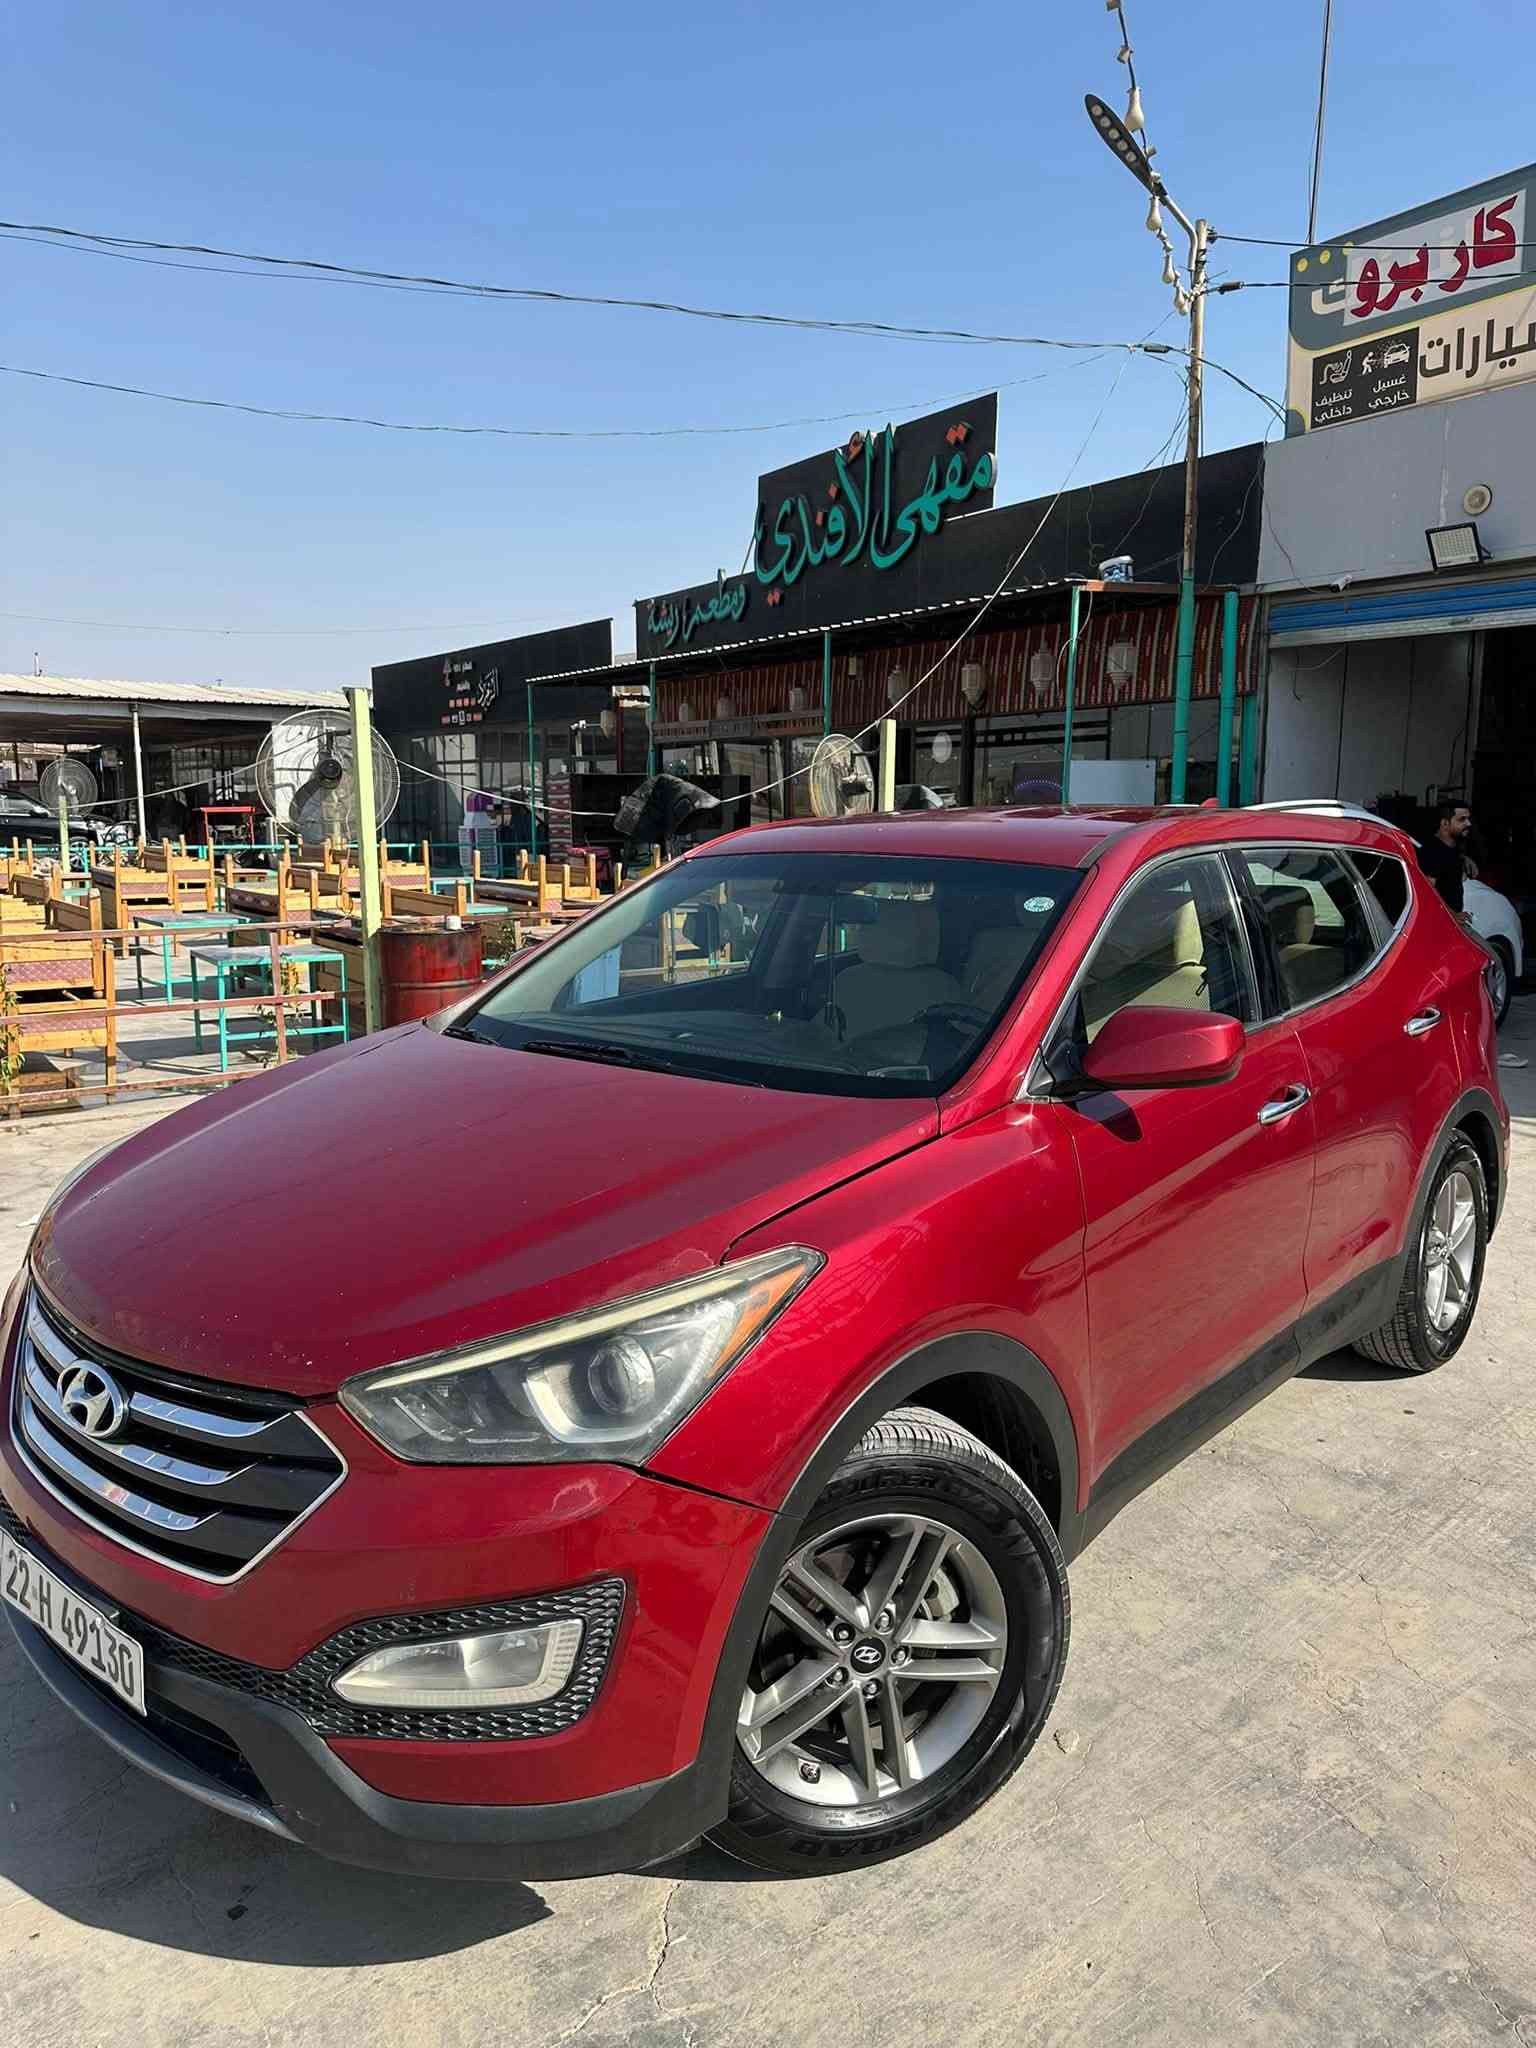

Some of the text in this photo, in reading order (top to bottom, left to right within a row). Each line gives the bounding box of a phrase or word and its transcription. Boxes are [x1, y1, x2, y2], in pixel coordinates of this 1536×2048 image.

[1438, 194, 1518, 293] كار
[1350, 242, 1430, 318] برو
[1372, 373, 1408, 393] غسيل
[1315, 388, 1353, 408] تنظيف
[1367, 389, 1411, 409] خارجي
[1314, 404, 1353, 424] داخلي
[6, 1549, 135, 1698] 22 H 49130
